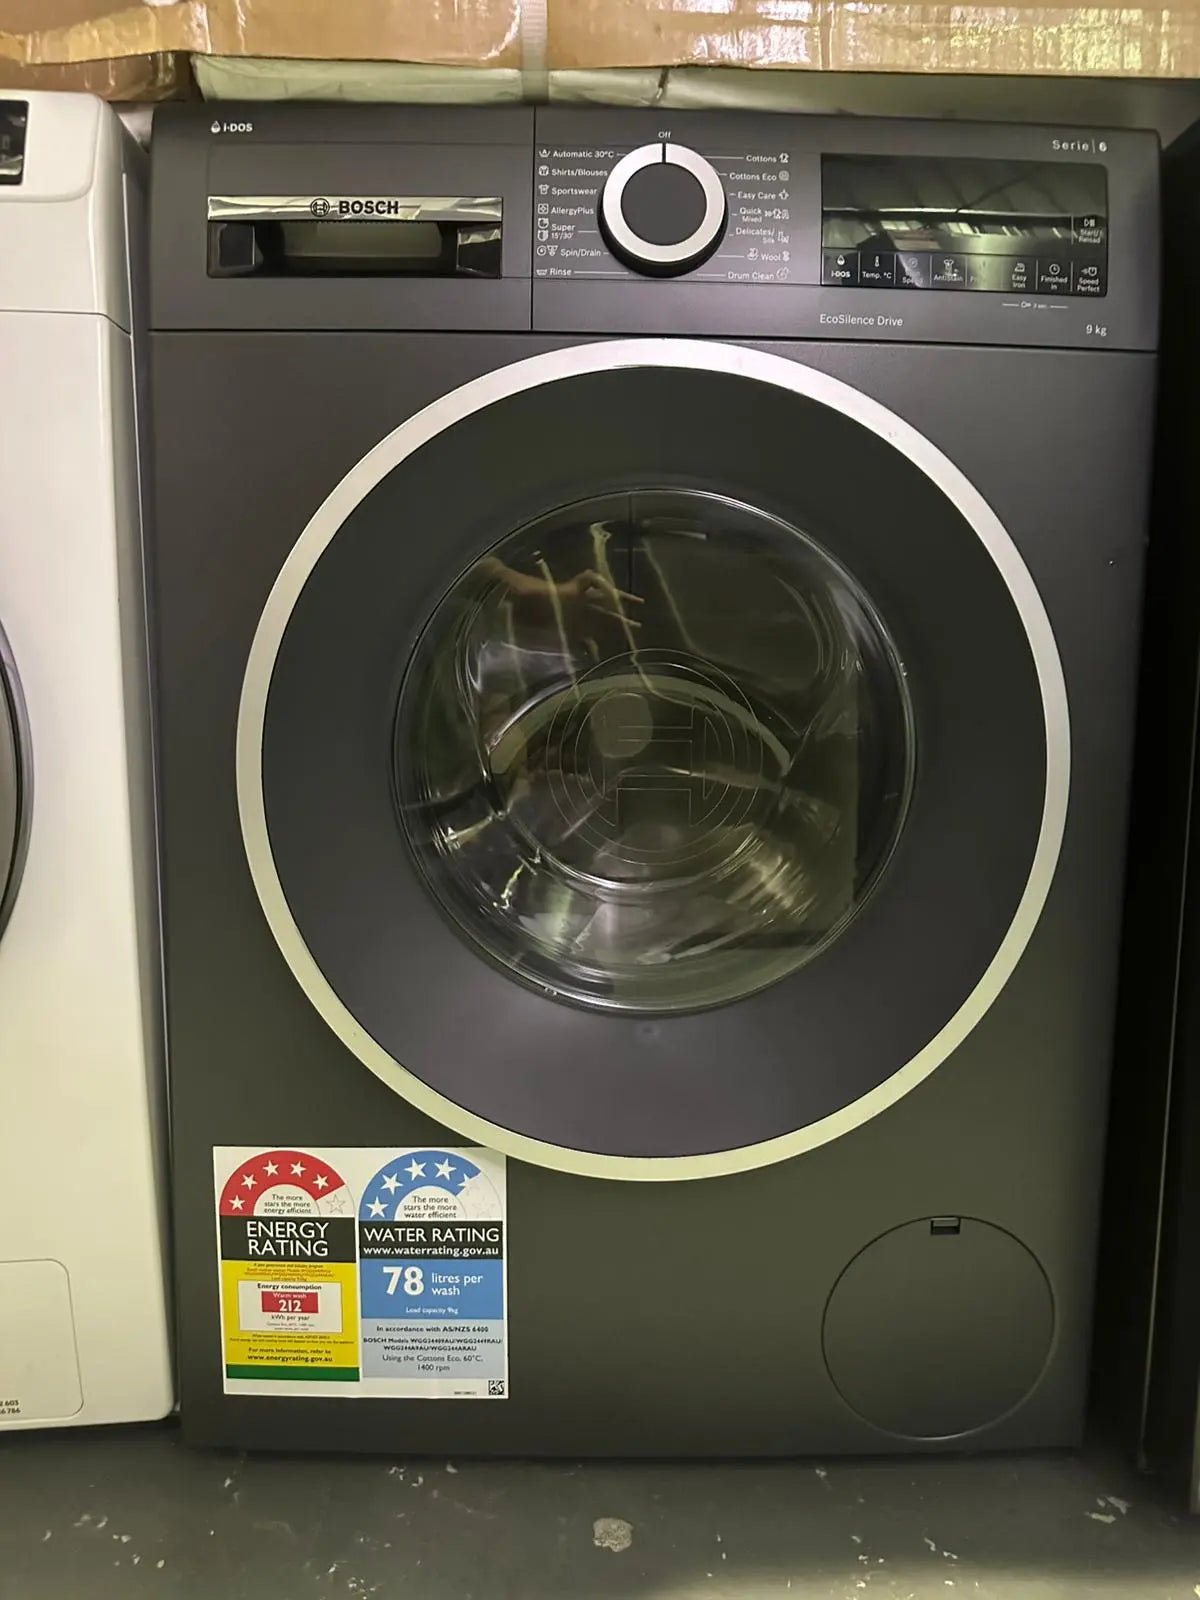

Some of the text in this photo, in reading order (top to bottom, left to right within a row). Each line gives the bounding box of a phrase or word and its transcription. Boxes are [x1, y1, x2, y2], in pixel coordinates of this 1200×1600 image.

[658, 131, 671, 139] Off
[1052, 139, 1108, 152] Serie 6
[552, 150, 593, 158] Automatic
[746, 154, 777, 163] Cottons
[551, 168, 608, 177] Shirts/Blouses
[729, 172, 777, 181] Cottons Eco
[551, 187, 597, 196] Sportswear
[737, 191, 776, 200] Easy Care
[339, 200, 399, 214] BOSCH
[551, 207, 594, 216] AllergyPlus
[740, 207, 762, 215] Quick
[551, 224, 576, 232] Super
[736, 227, 775, 236] Delicates/
[560, 248, 601, 258] Spin/Drain
[761, 253, 781, 261] Wool
[549, 267, 572, 276] Rinse
[728, 271, 774, 280] Drum Clean
[862, 272, 882, 280] Temp.
[1012, 274, 1027, 282] Easy
[1040, 275, 1068, 284] Finished
[1079, 277, 1099, 285] Speed
[1077, 284, 1100, 293] Perfect
[820, 314, 904, 327] EcoSilence Drive
[1086, 324, 1108, 337] 9 kg
[246, 1220, 329, 1238] ENERGY
[364, 1228, 500, 1242] WATER RATING
[248, 1239, 328, 1256] RATING
[364, 1246, 499, 1257] www.waterrating.gov.au
[383, 1266, 424, 1296] 78
[432, 1272, 484, 1286] litres per
[257, 1282, 280, 1290] Energy
[431, 1285, 460, 1296] wash
[278, 1300, 302, 1312] 212
[406, 1306, 421, 1314] Load
[422, 1307, 446, 1315] capacity
[248, 1354, 333, 1362] www.energyrating.gov.au
[382, 1354, 402, 1362] Using
[403, 1354, 414, 1362] the
[416, 1354, 445, 1362] Cottons
